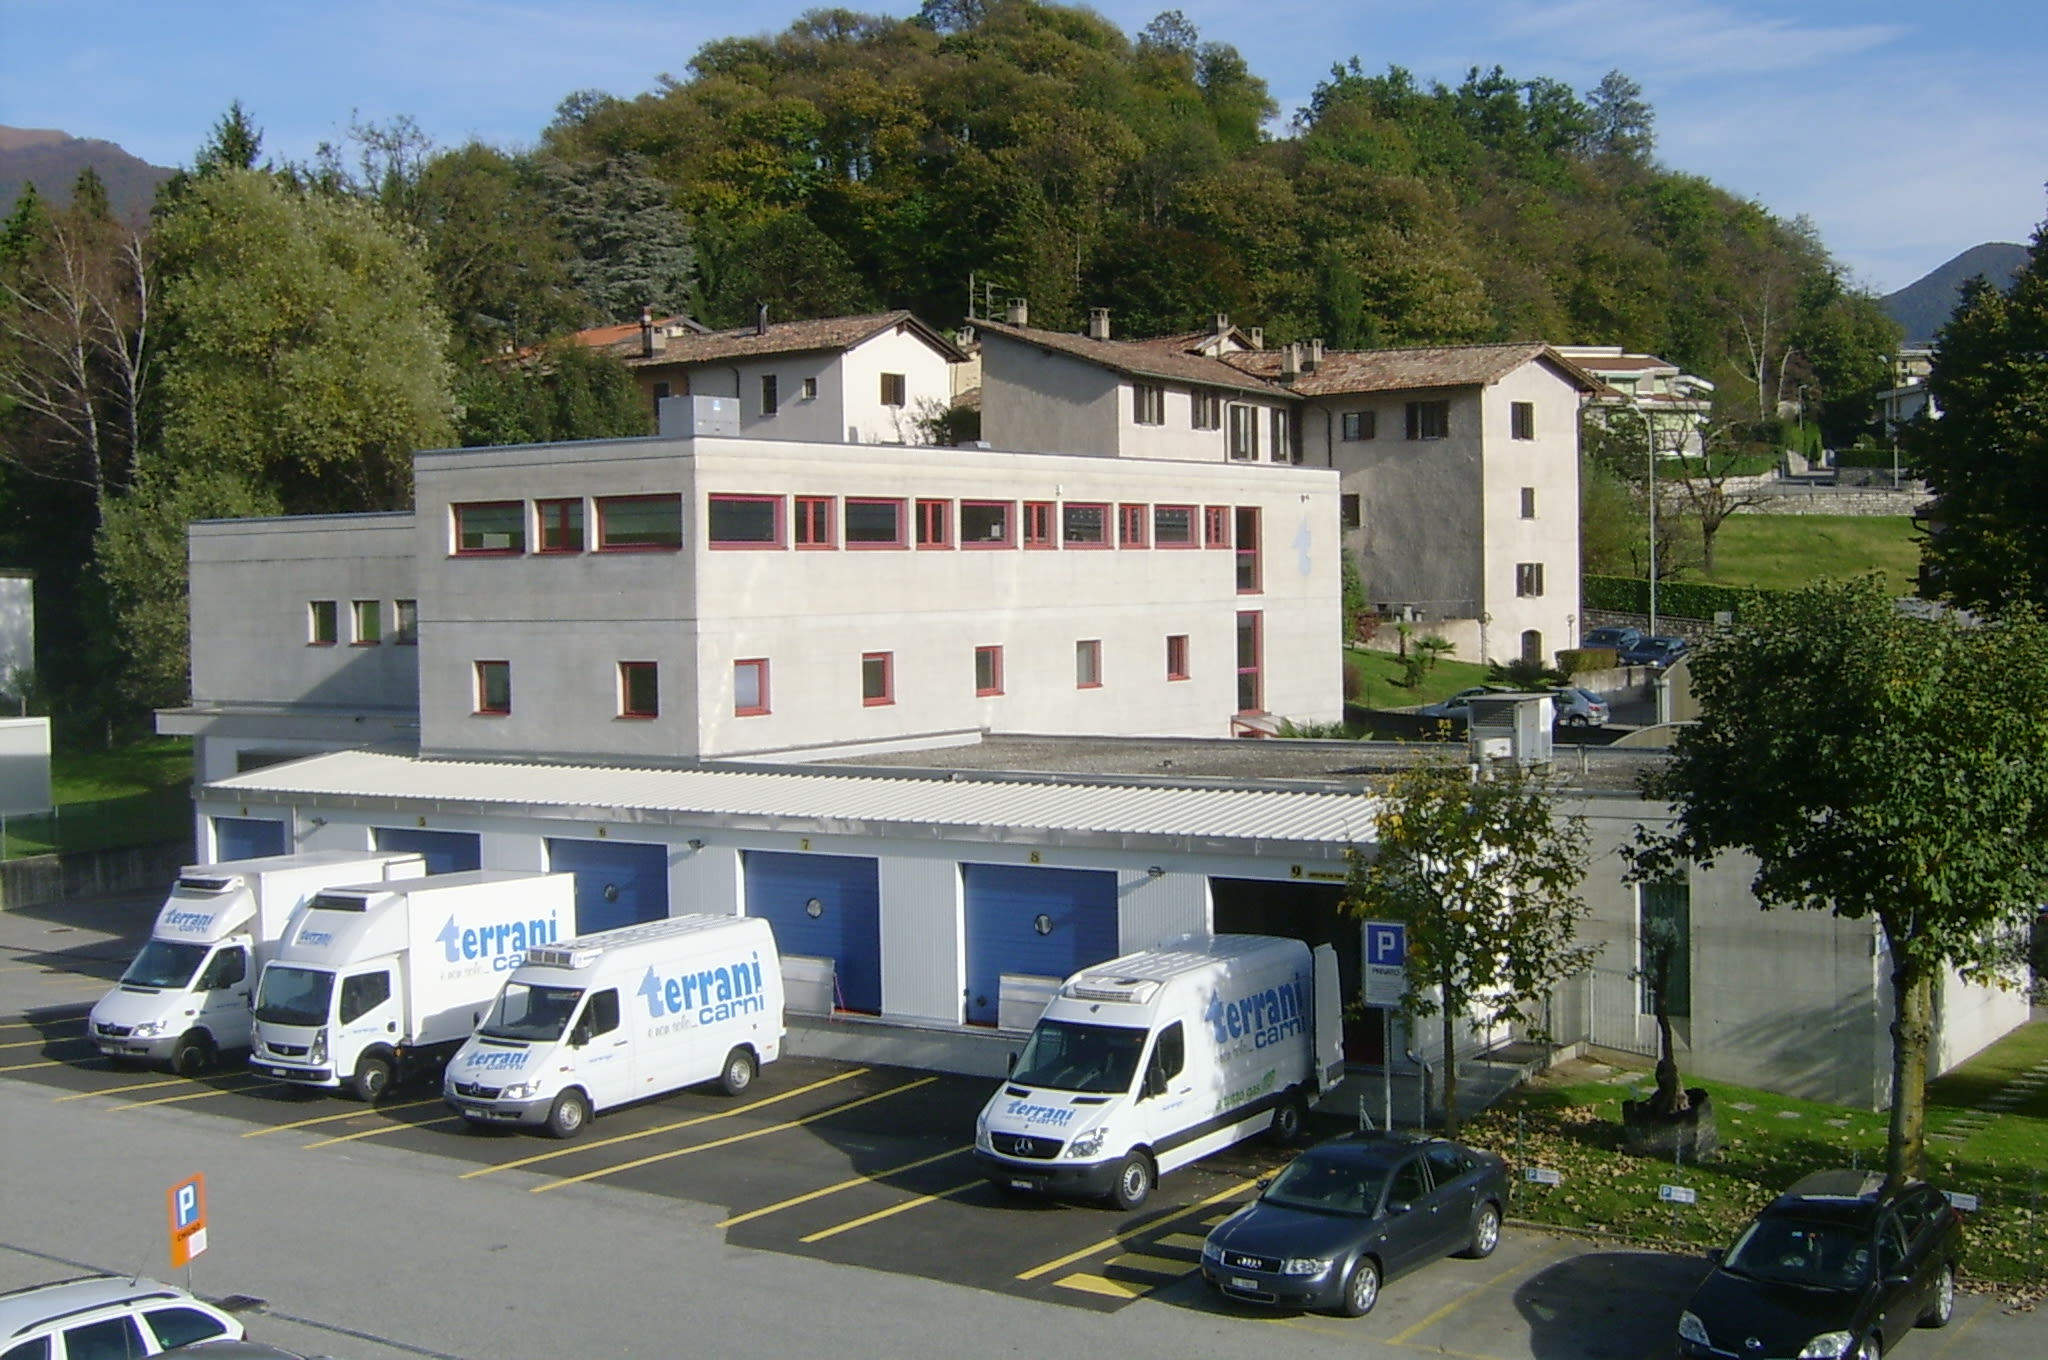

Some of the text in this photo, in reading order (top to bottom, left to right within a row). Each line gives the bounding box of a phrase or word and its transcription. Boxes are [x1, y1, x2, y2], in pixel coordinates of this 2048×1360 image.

[1291, 864, 1301, 879] 9
[165, 909, 216, 926] terrani
[435, 908, 557, 963] terrani
[1377, 930, 1396, 961] P
[637, 949, 763, 1019] terrani
[699, 994, 765, 1025] carni
[1204, 972, 1303, 1044] terrani
[1255, 1016, 1306, 1049] carni
[466, 1051, 532, 1067] terrani
[1008, 1100, 1077, 1120] terrani
[1027, 1115, 1069, 1127] carni
[179, 1185, 195, 1226] P
